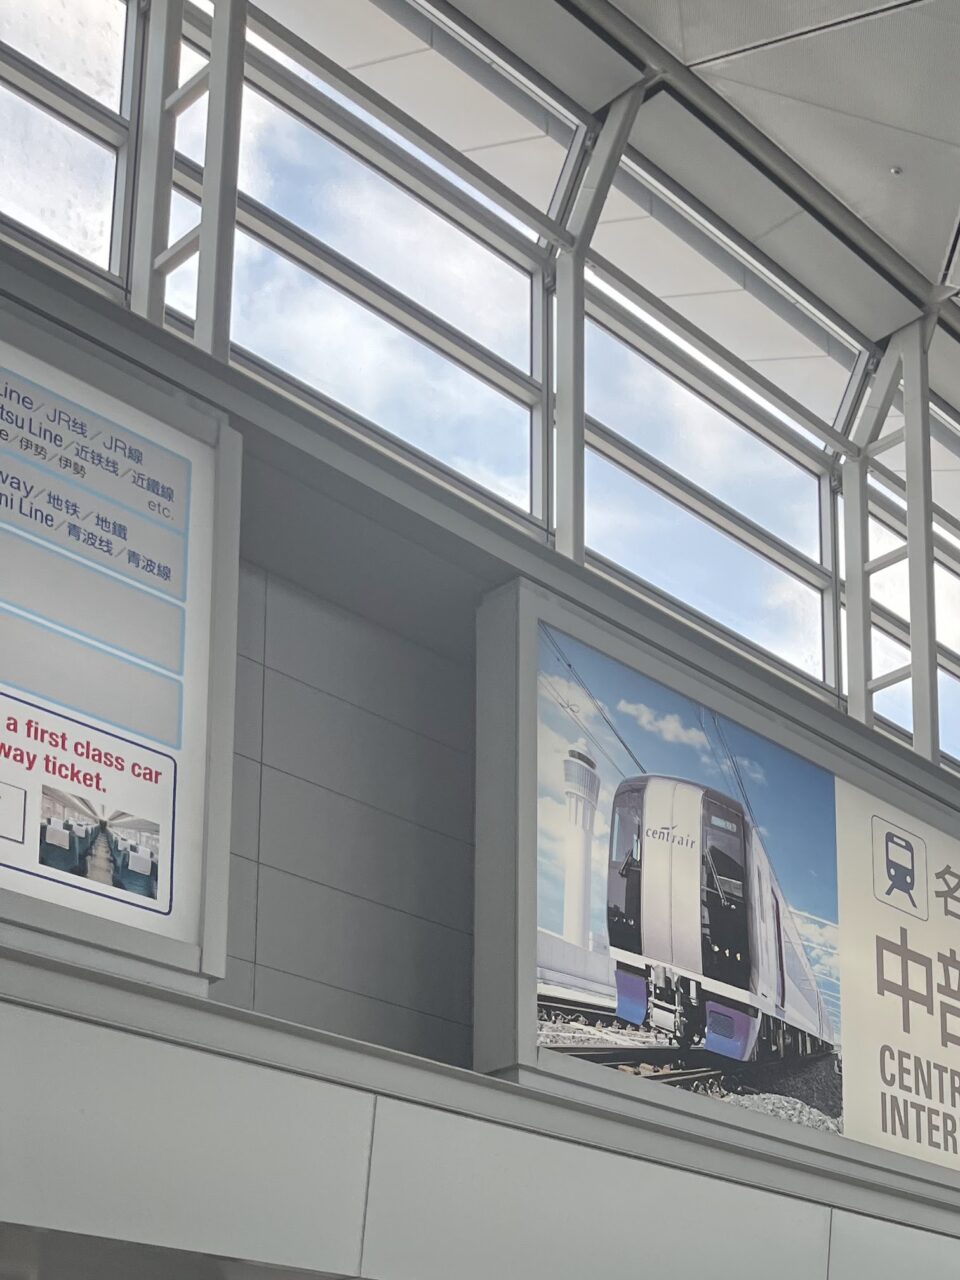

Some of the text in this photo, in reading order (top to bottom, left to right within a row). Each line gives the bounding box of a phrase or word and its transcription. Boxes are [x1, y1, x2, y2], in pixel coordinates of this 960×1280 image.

[0, 382, 33, 410] ine
[29, 418, 63, 448] Line
[19, 497, 54, 528] Line
[148, 499, 174, 521] etc.
[6, 716, 162, 784] a first class car
[44, 754, 107, 793] ticket.
